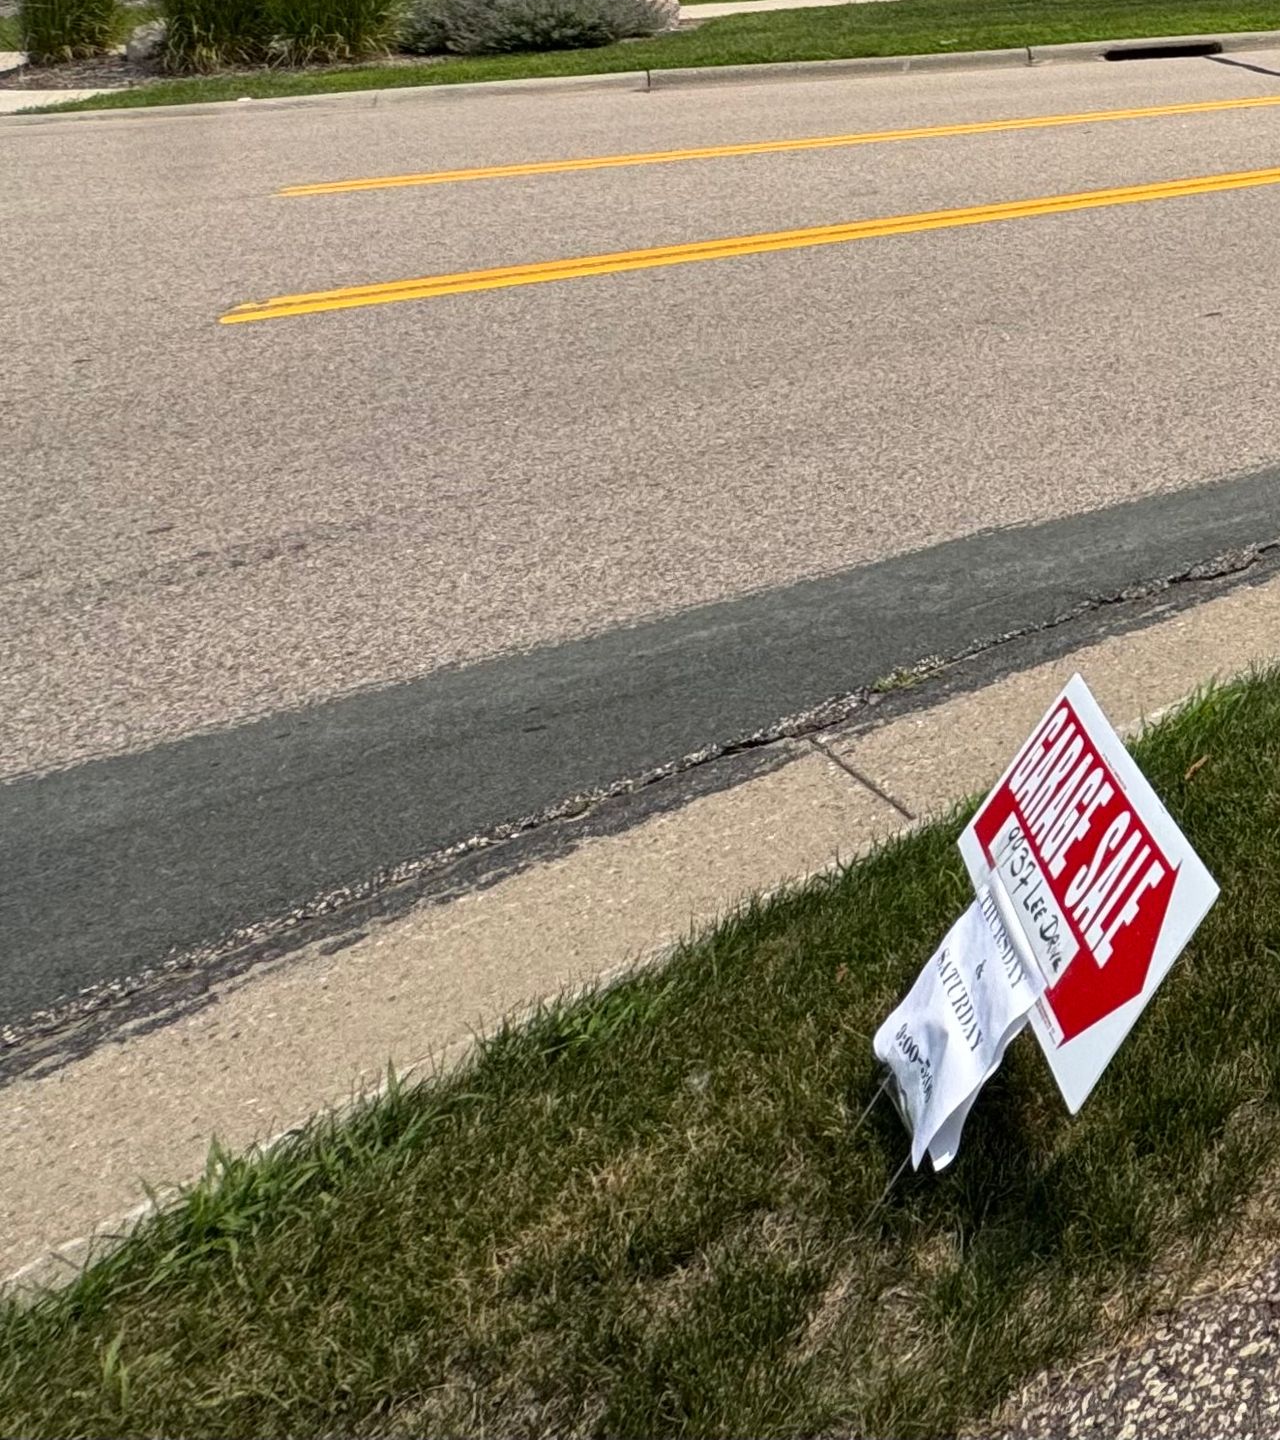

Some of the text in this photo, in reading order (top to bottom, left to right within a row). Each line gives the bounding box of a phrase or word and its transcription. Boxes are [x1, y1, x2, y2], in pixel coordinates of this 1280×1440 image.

[1008, 707, 1166, 970] GARAGE SALE
[979, 890, 1027, 989] THURSDAY
[1022, 879, 1048, 923] LEE
[937, 947, 984, 1052] SATURDAY
